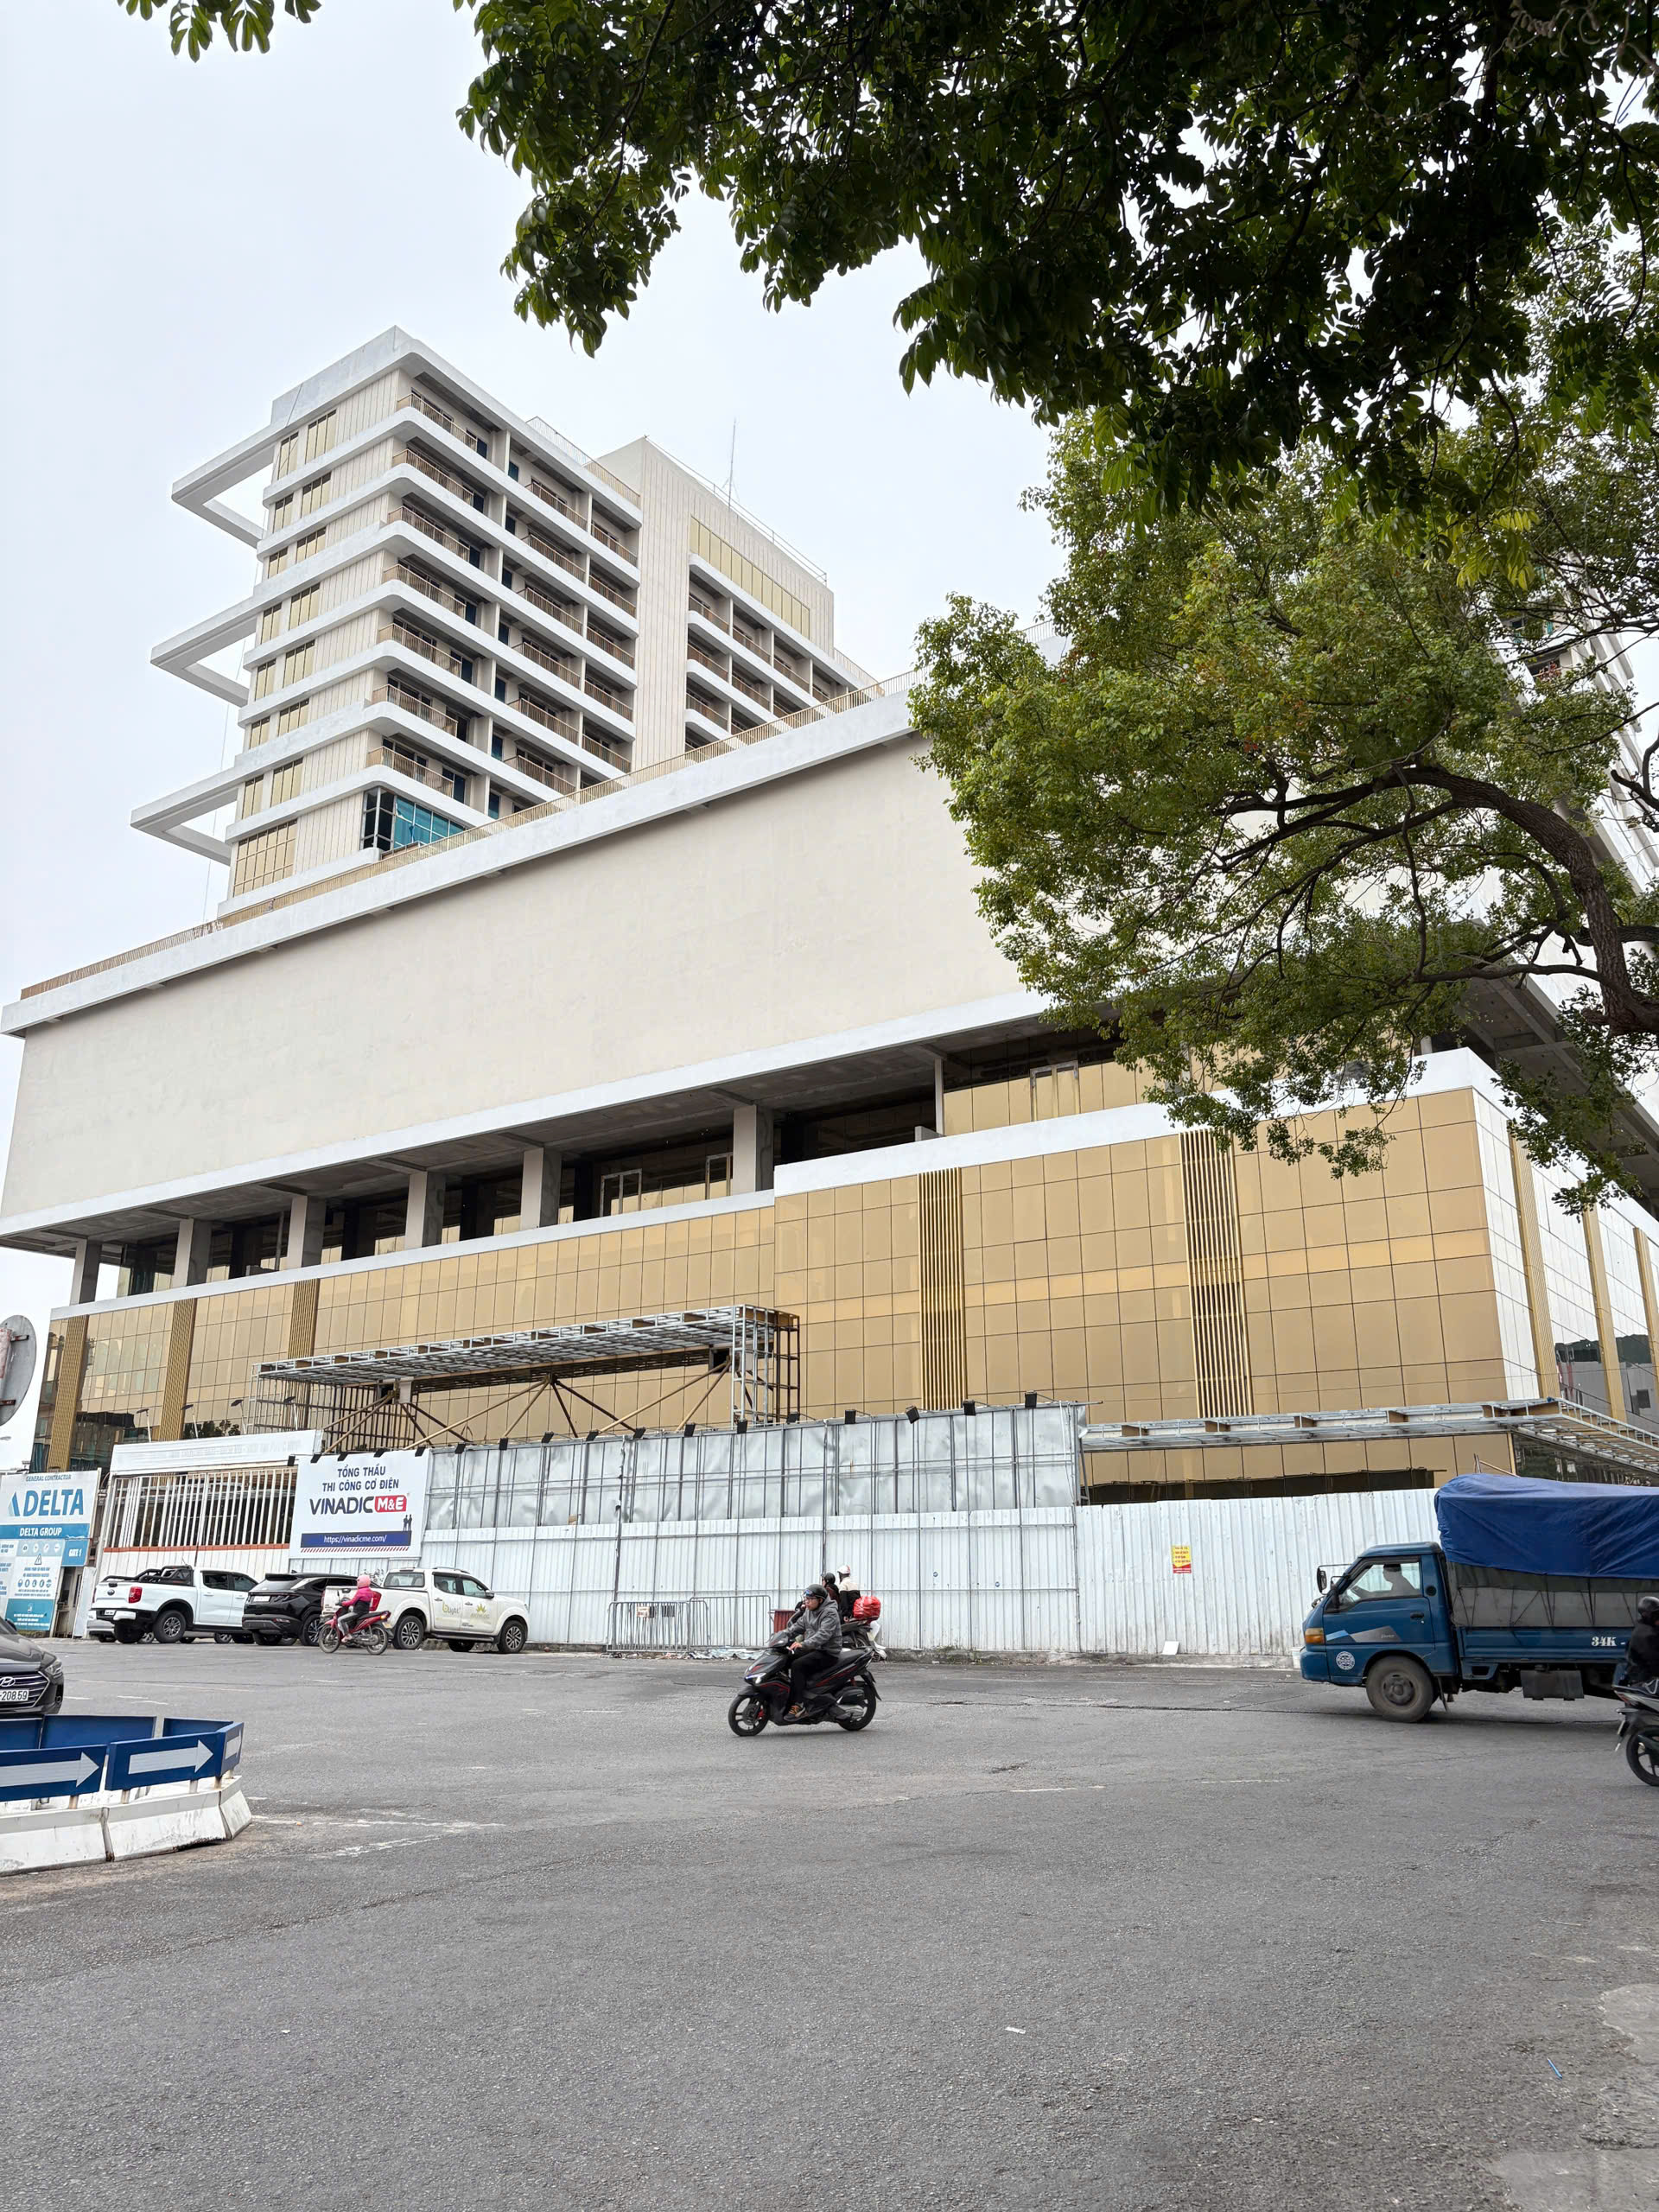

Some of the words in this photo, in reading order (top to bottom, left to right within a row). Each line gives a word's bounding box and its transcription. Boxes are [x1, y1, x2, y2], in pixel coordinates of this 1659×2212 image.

[322, 1482, 335, 1492] THI
[339, 1479, 361, 1491] CÔNG
[365, 1478, 377, 1490] CƠ
[379, 1477, 399, 1491] ĐIỆN
[22, 1489, 84, 1516] DELTA
[309, 1496, 374, 1515] VINADIC
[377, 1497, 404, 1511] M&E
[19, 1528, 39, 1537] DELTA
[39, 1527, 62, 1536] GROUP
[323, 1534, 387, 1544] https://vinadicme.com/
[1591, 1636, 1618, 1647] 34K
